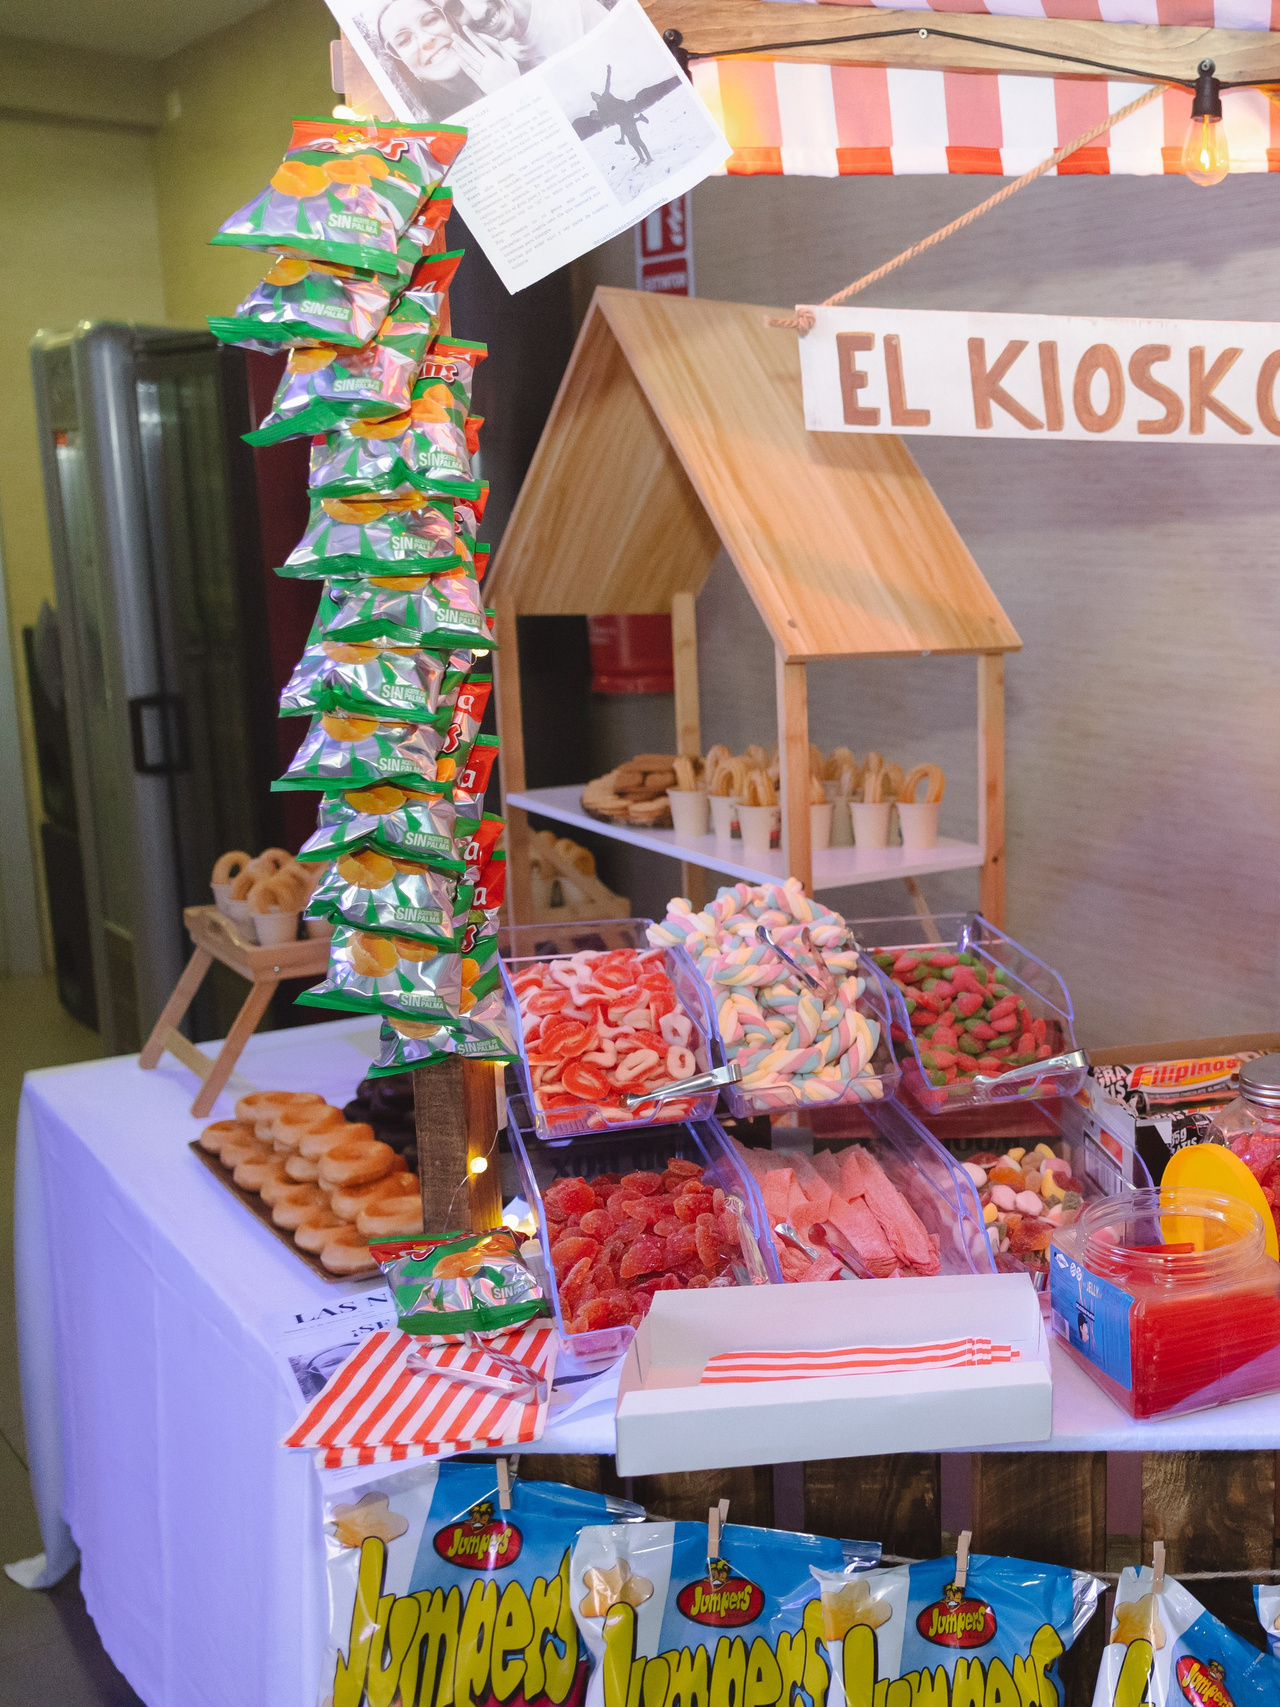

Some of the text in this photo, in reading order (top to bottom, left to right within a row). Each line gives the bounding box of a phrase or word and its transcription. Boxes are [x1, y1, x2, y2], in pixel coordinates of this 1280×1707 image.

[328, 213, 352, 229] SIN
[351, 223, 379, 234] PALMA
[301, 300, 325, 317] SIN
[324, 311, 349, 321] PALMA
[333, 378, 356, 392] SIN
[836, 331, 931, 428] EL
[418, 452, 440, 466] SIN
[390, 536, 413, 550] SIN
[436, 608, 458, 622] SIN
[382, 684, 404, 700] SIN
[404, 693, 426, 704] PALMA
[379, 758, 400, 771] SIN
[405, 832, 427, 847] SIN
[426, 842, 450, 851] PALMA
[396, 907, 417, 922] SIN
[400, 994, 421, 1008] SIN
[457, 1043, 476, 1054] SIN
[476, 1044, 499, 1052] PALMA
[1129, 1057, 1238, 1089] Filipinos
[492, 1286, 512, 1299] SIN
[1086, 1281, 1100, 1298] JELLY
[295, 1300, 358, 1324] LAS
[447, 1528, 512, 1560] Jumpers
[692, 1583, 752, 1615] Jumpers
[334, 1535, 584, 1707] Jumpers
[928, 1606, 986, 1638] Jumpers
[1182, 1662, 1235, 1707] Jumpers
